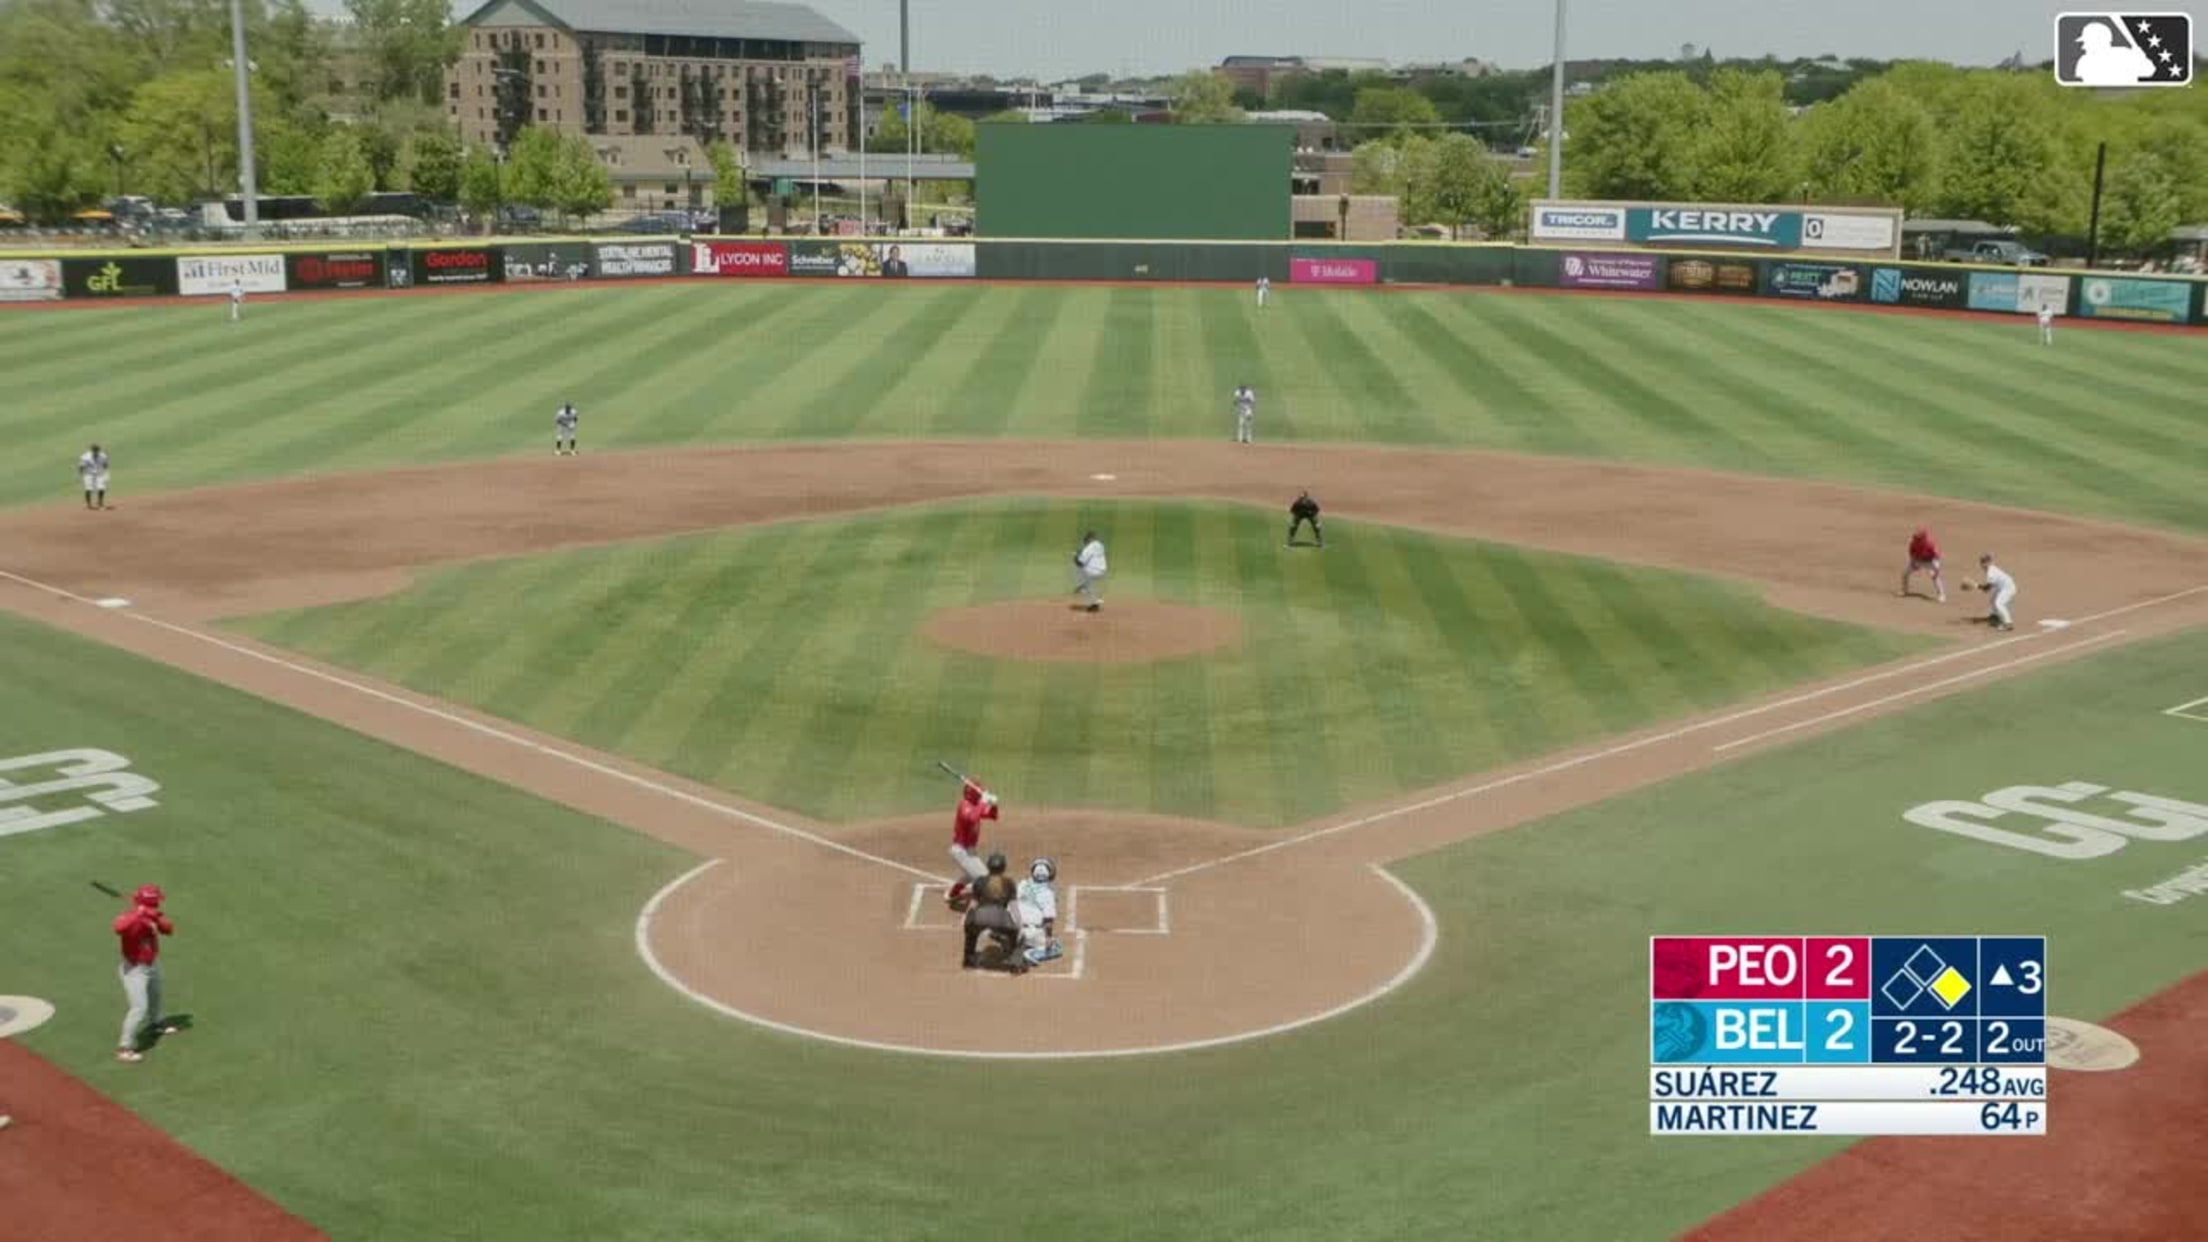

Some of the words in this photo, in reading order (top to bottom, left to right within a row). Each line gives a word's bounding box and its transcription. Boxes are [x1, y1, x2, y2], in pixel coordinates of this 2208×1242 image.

[1651, 210, 1780, 232] KERRY
[1807, 220, 1822, 237] 0
[426, 252, 488, 268] Gordon
[720, 252, 760, 266] LYCON
[762, 253, 785, 266] INC
[1588, 264, 1652, 279] Whitewater
[86, 274, 124, 291] GFL
[1901, 278, 1958, 294] NOWLAN
